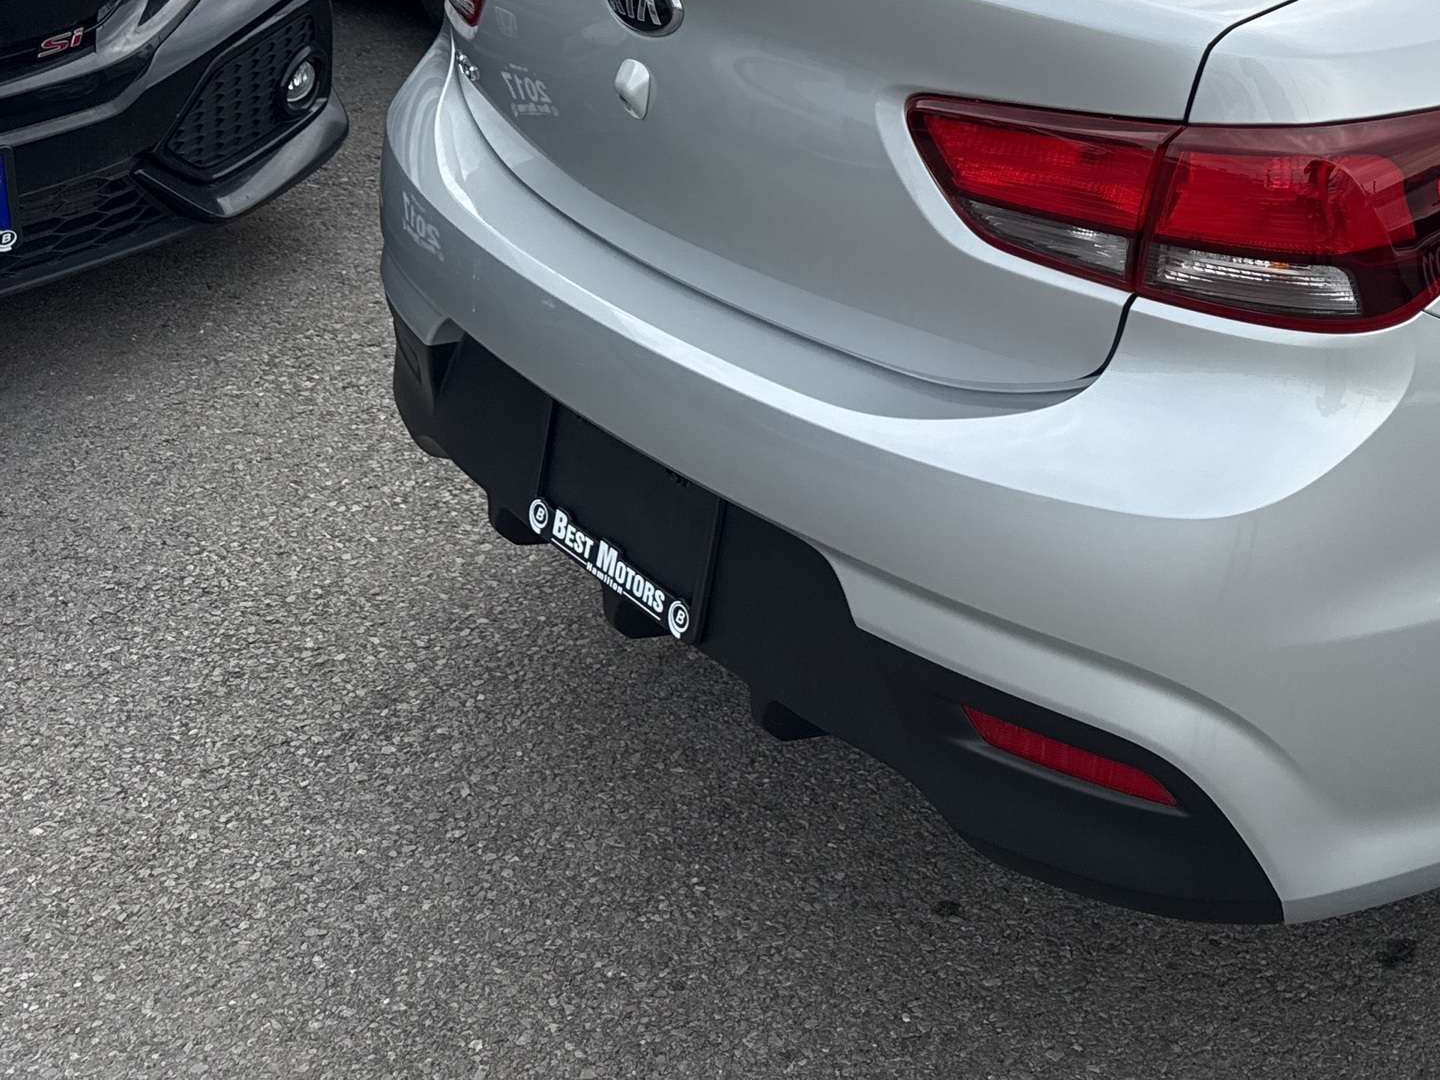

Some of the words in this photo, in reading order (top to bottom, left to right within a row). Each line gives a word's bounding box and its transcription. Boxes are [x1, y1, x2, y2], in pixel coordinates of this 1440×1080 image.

[37, 26, 85, 58] Si
[551, 508, 594, 560] BEST
[596, 538, 666, 614] MOTORS
[585, 561, 624, 595] Hamilton
